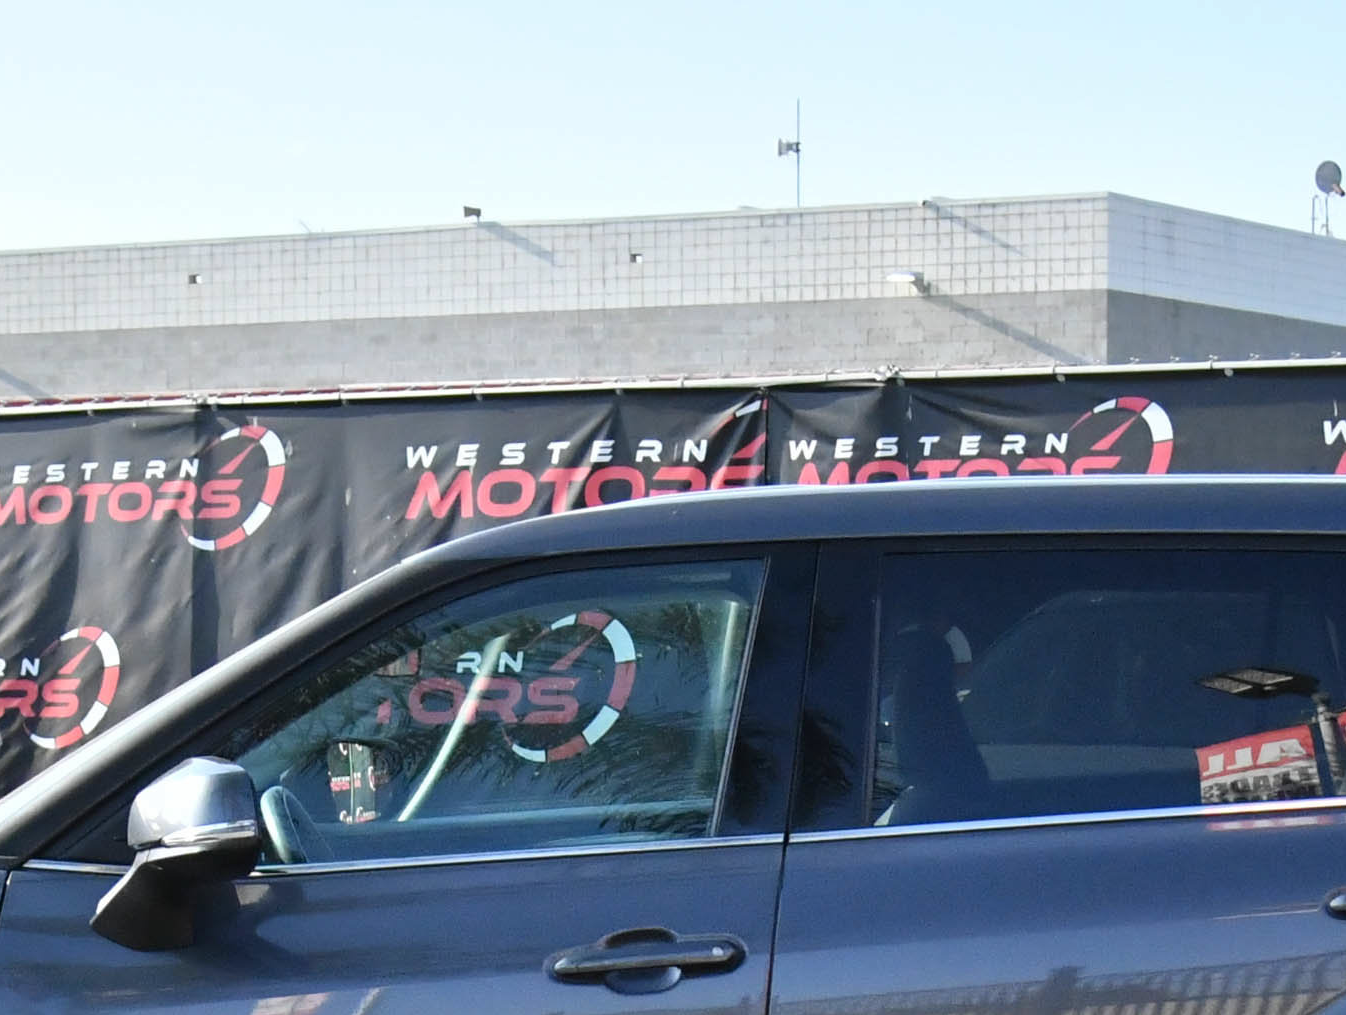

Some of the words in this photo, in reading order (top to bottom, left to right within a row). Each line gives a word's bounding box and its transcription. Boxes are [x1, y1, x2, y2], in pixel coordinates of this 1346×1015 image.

[407, 439, 707, 469] WESTERN
[789, 433, 1067, 460] WESTERN
[377, 677, 581, 725] ORS
